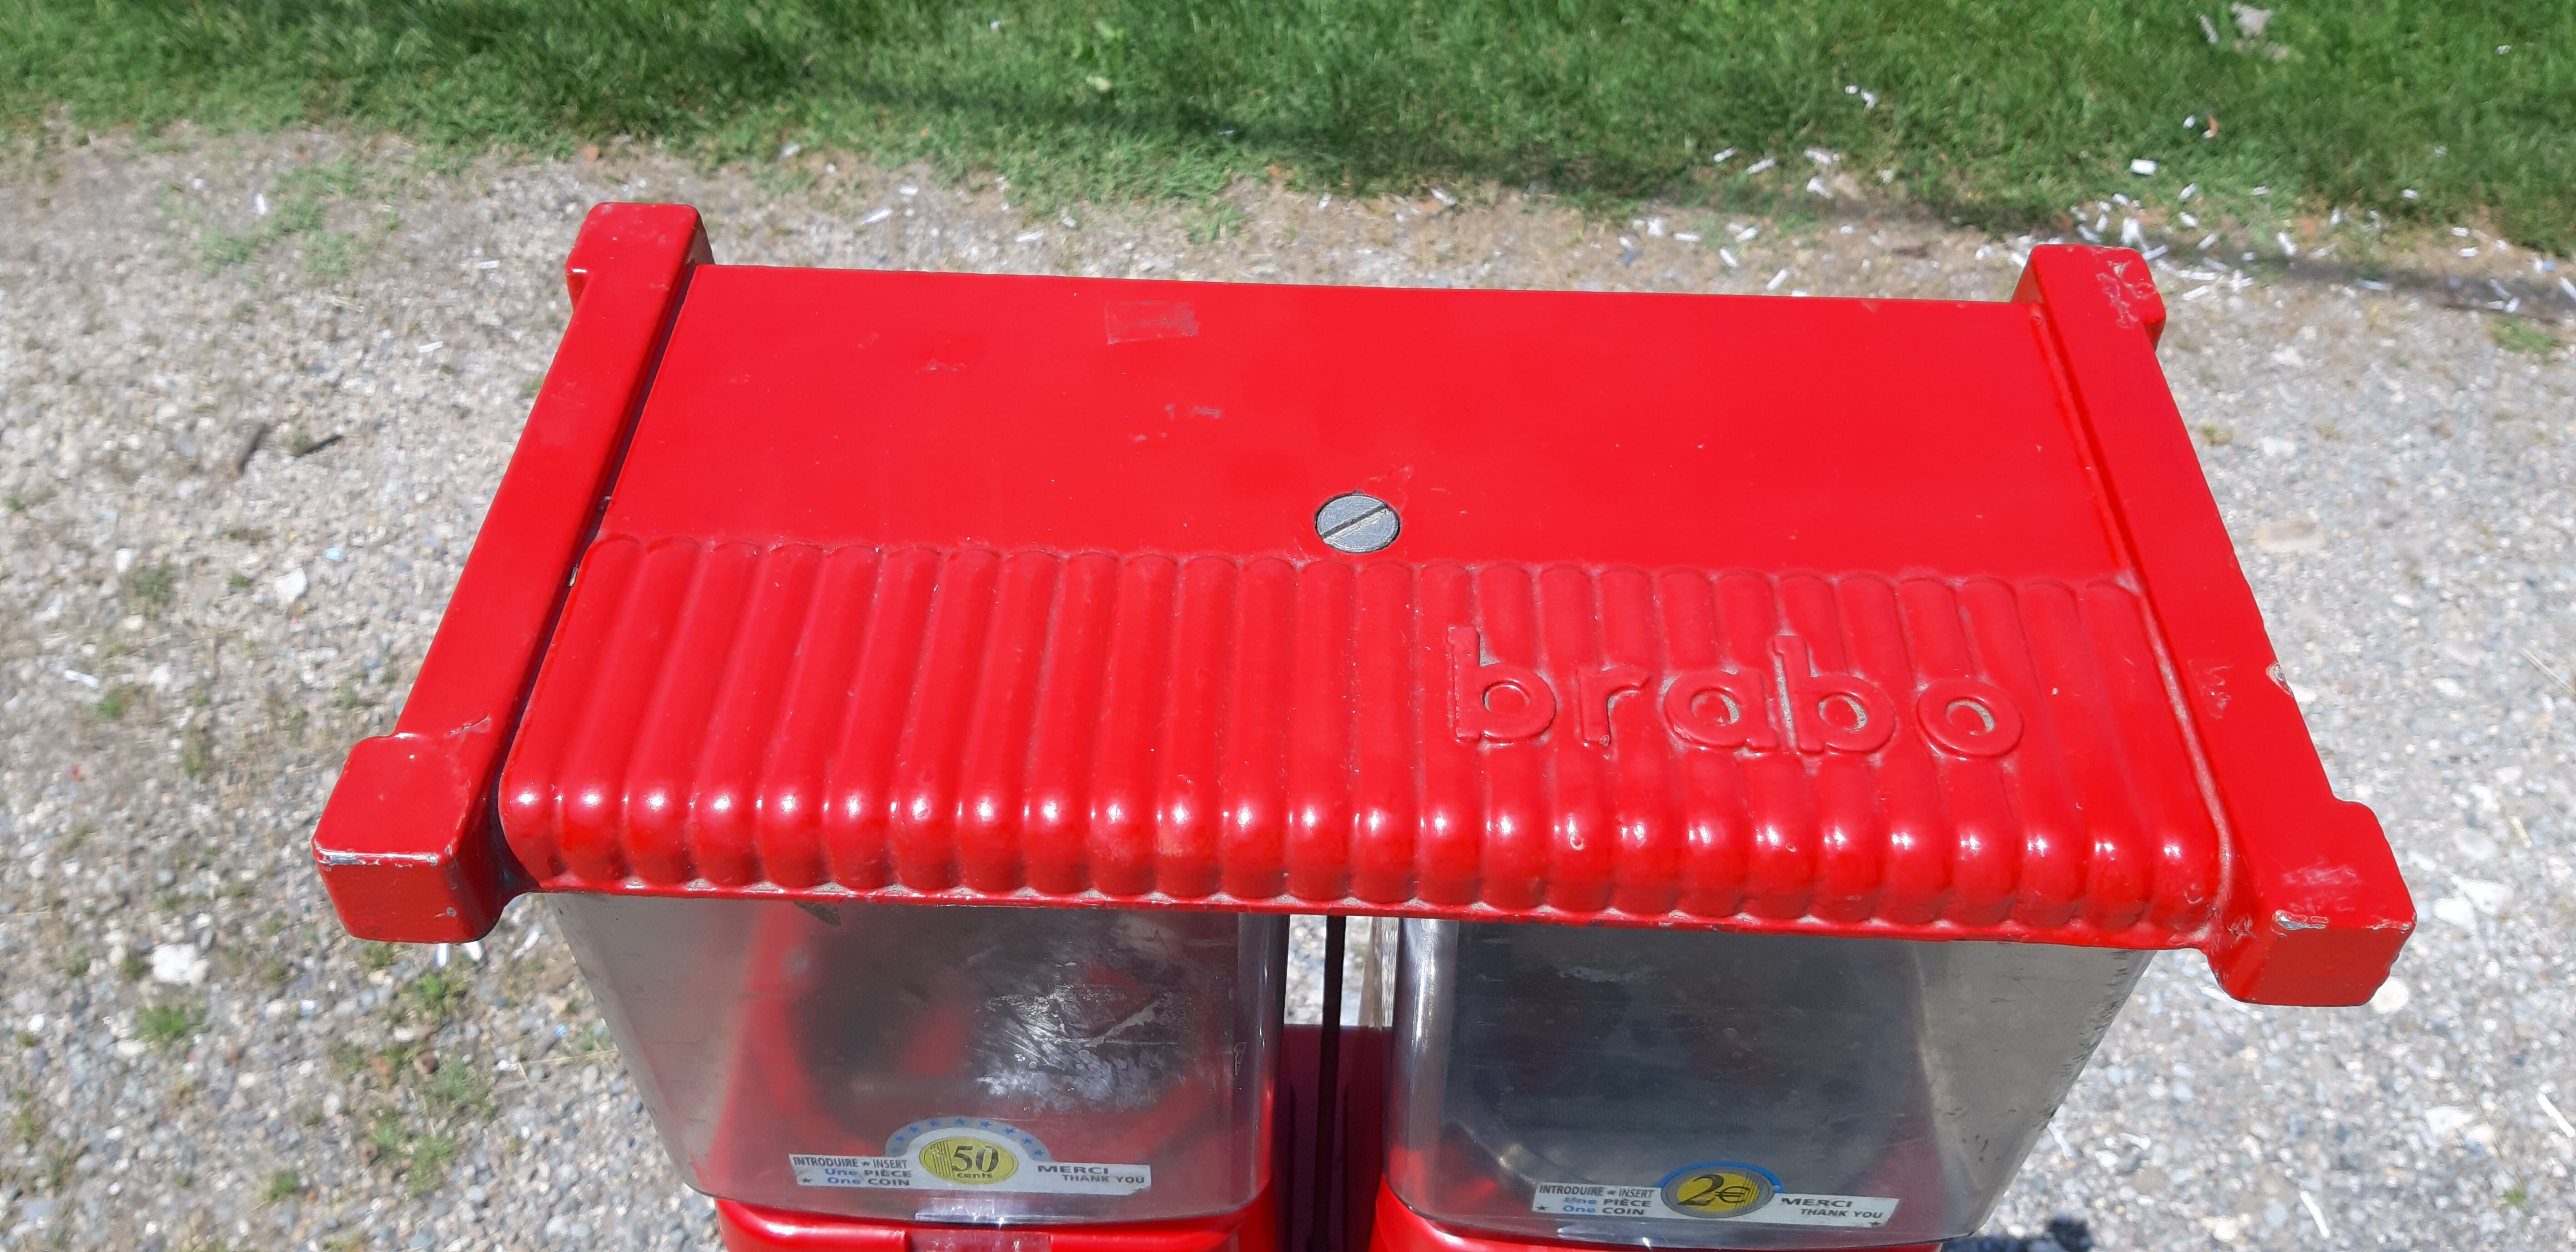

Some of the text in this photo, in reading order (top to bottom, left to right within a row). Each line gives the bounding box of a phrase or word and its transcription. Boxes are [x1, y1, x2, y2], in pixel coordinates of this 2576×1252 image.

[1448, 626, 2022, 756] brabo
[793, 1156, 907, 1168] INTRODUIRE INSERT
[951, 1146, 999, 1172] 50
[1037, 1165, 1108, 1174] MERCI
[1539, 1184, 1655, 1198] INTRODUIRE INSERT
[1603, 1198, 1652, 1207] PIÈCE
[1781, 1197, 1852, 1208] MERCI
[1602, 1207, 1645, 1215] COIN
[1800, 1208, 1848, 1217] THANK
